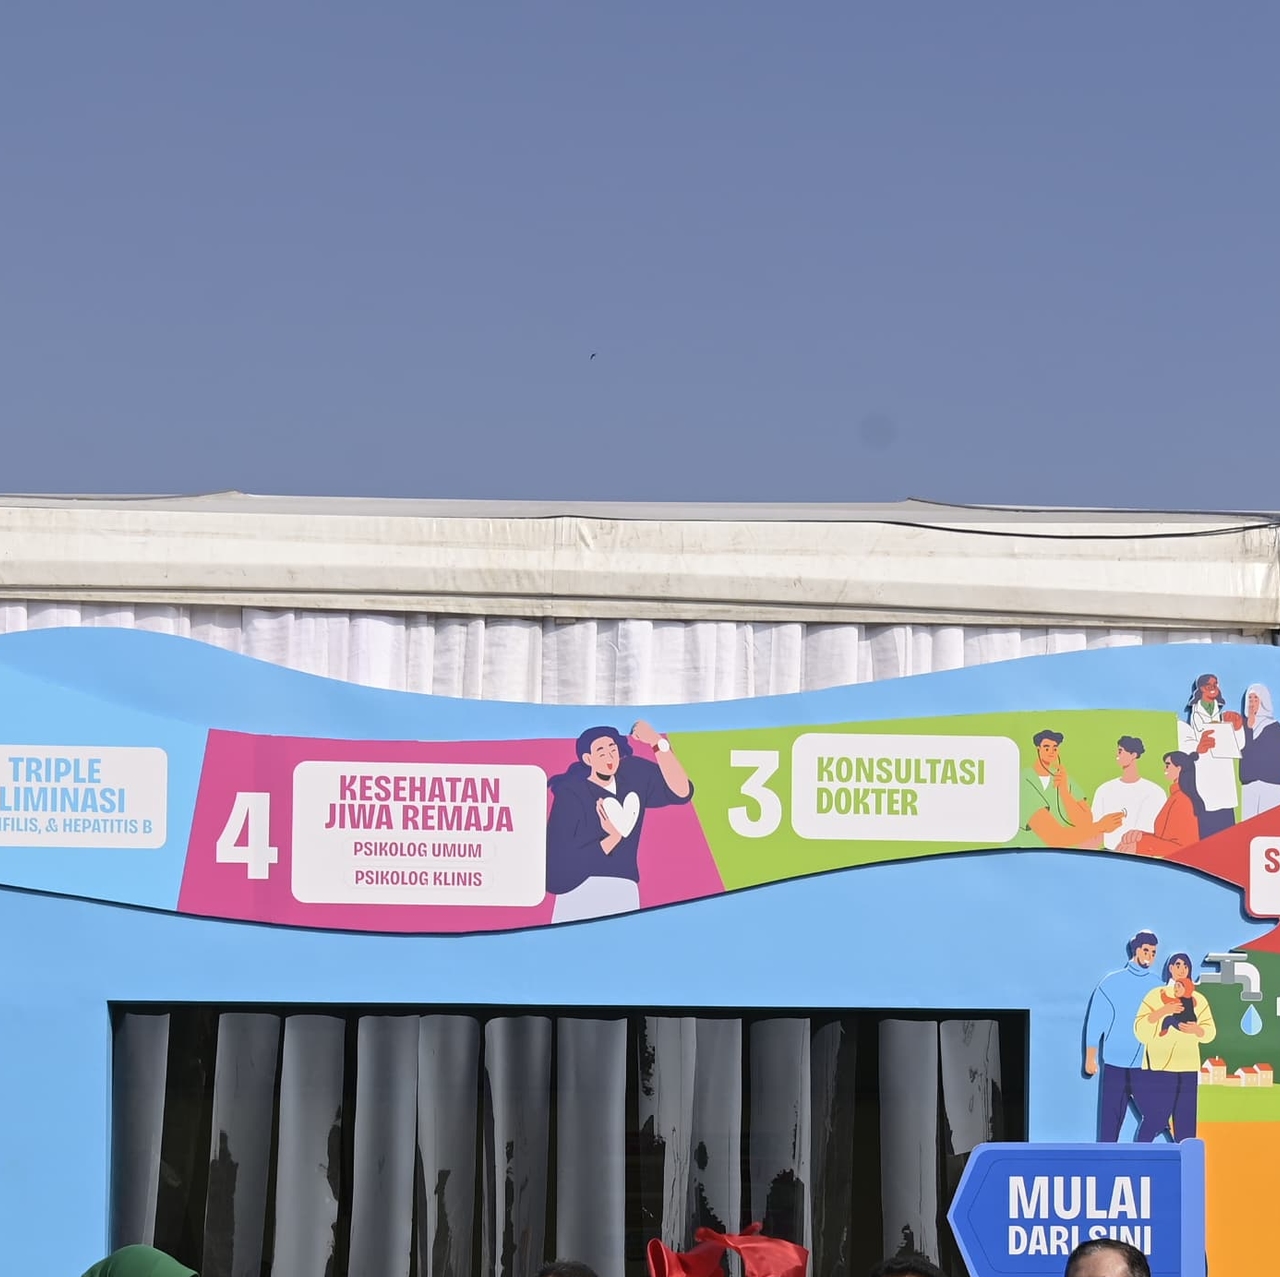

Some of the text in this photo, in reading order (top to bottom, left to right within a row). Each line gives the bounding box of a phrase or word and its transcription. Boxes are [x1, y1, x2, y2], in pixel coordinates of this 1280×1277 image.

[9, 756, 102, 785] TRIPLE
[816, 755, 985, 787] KONSULTASI
[340, 774, 500, 803] KESEHATAN
[728, 750, 782, 839] 3
[816, 787, 918, 816] DOKTER
[45, 818, 58, 834] &
[61, 818, 138, 834] HEPATITIS
[142, 819, 153, 834] B
[325, 803, 514, 833] JIWA REMAJA
[216, 792, 278, 880] 4
[353, 841, 482, 859] PSIKOLOG UMUM
[354, 869, 482, 887] PSIKOLOG KLINIS
[1008, 1176, 1151, 1220] MULAI
[1008, 1225, 1079, 1256] DARI
